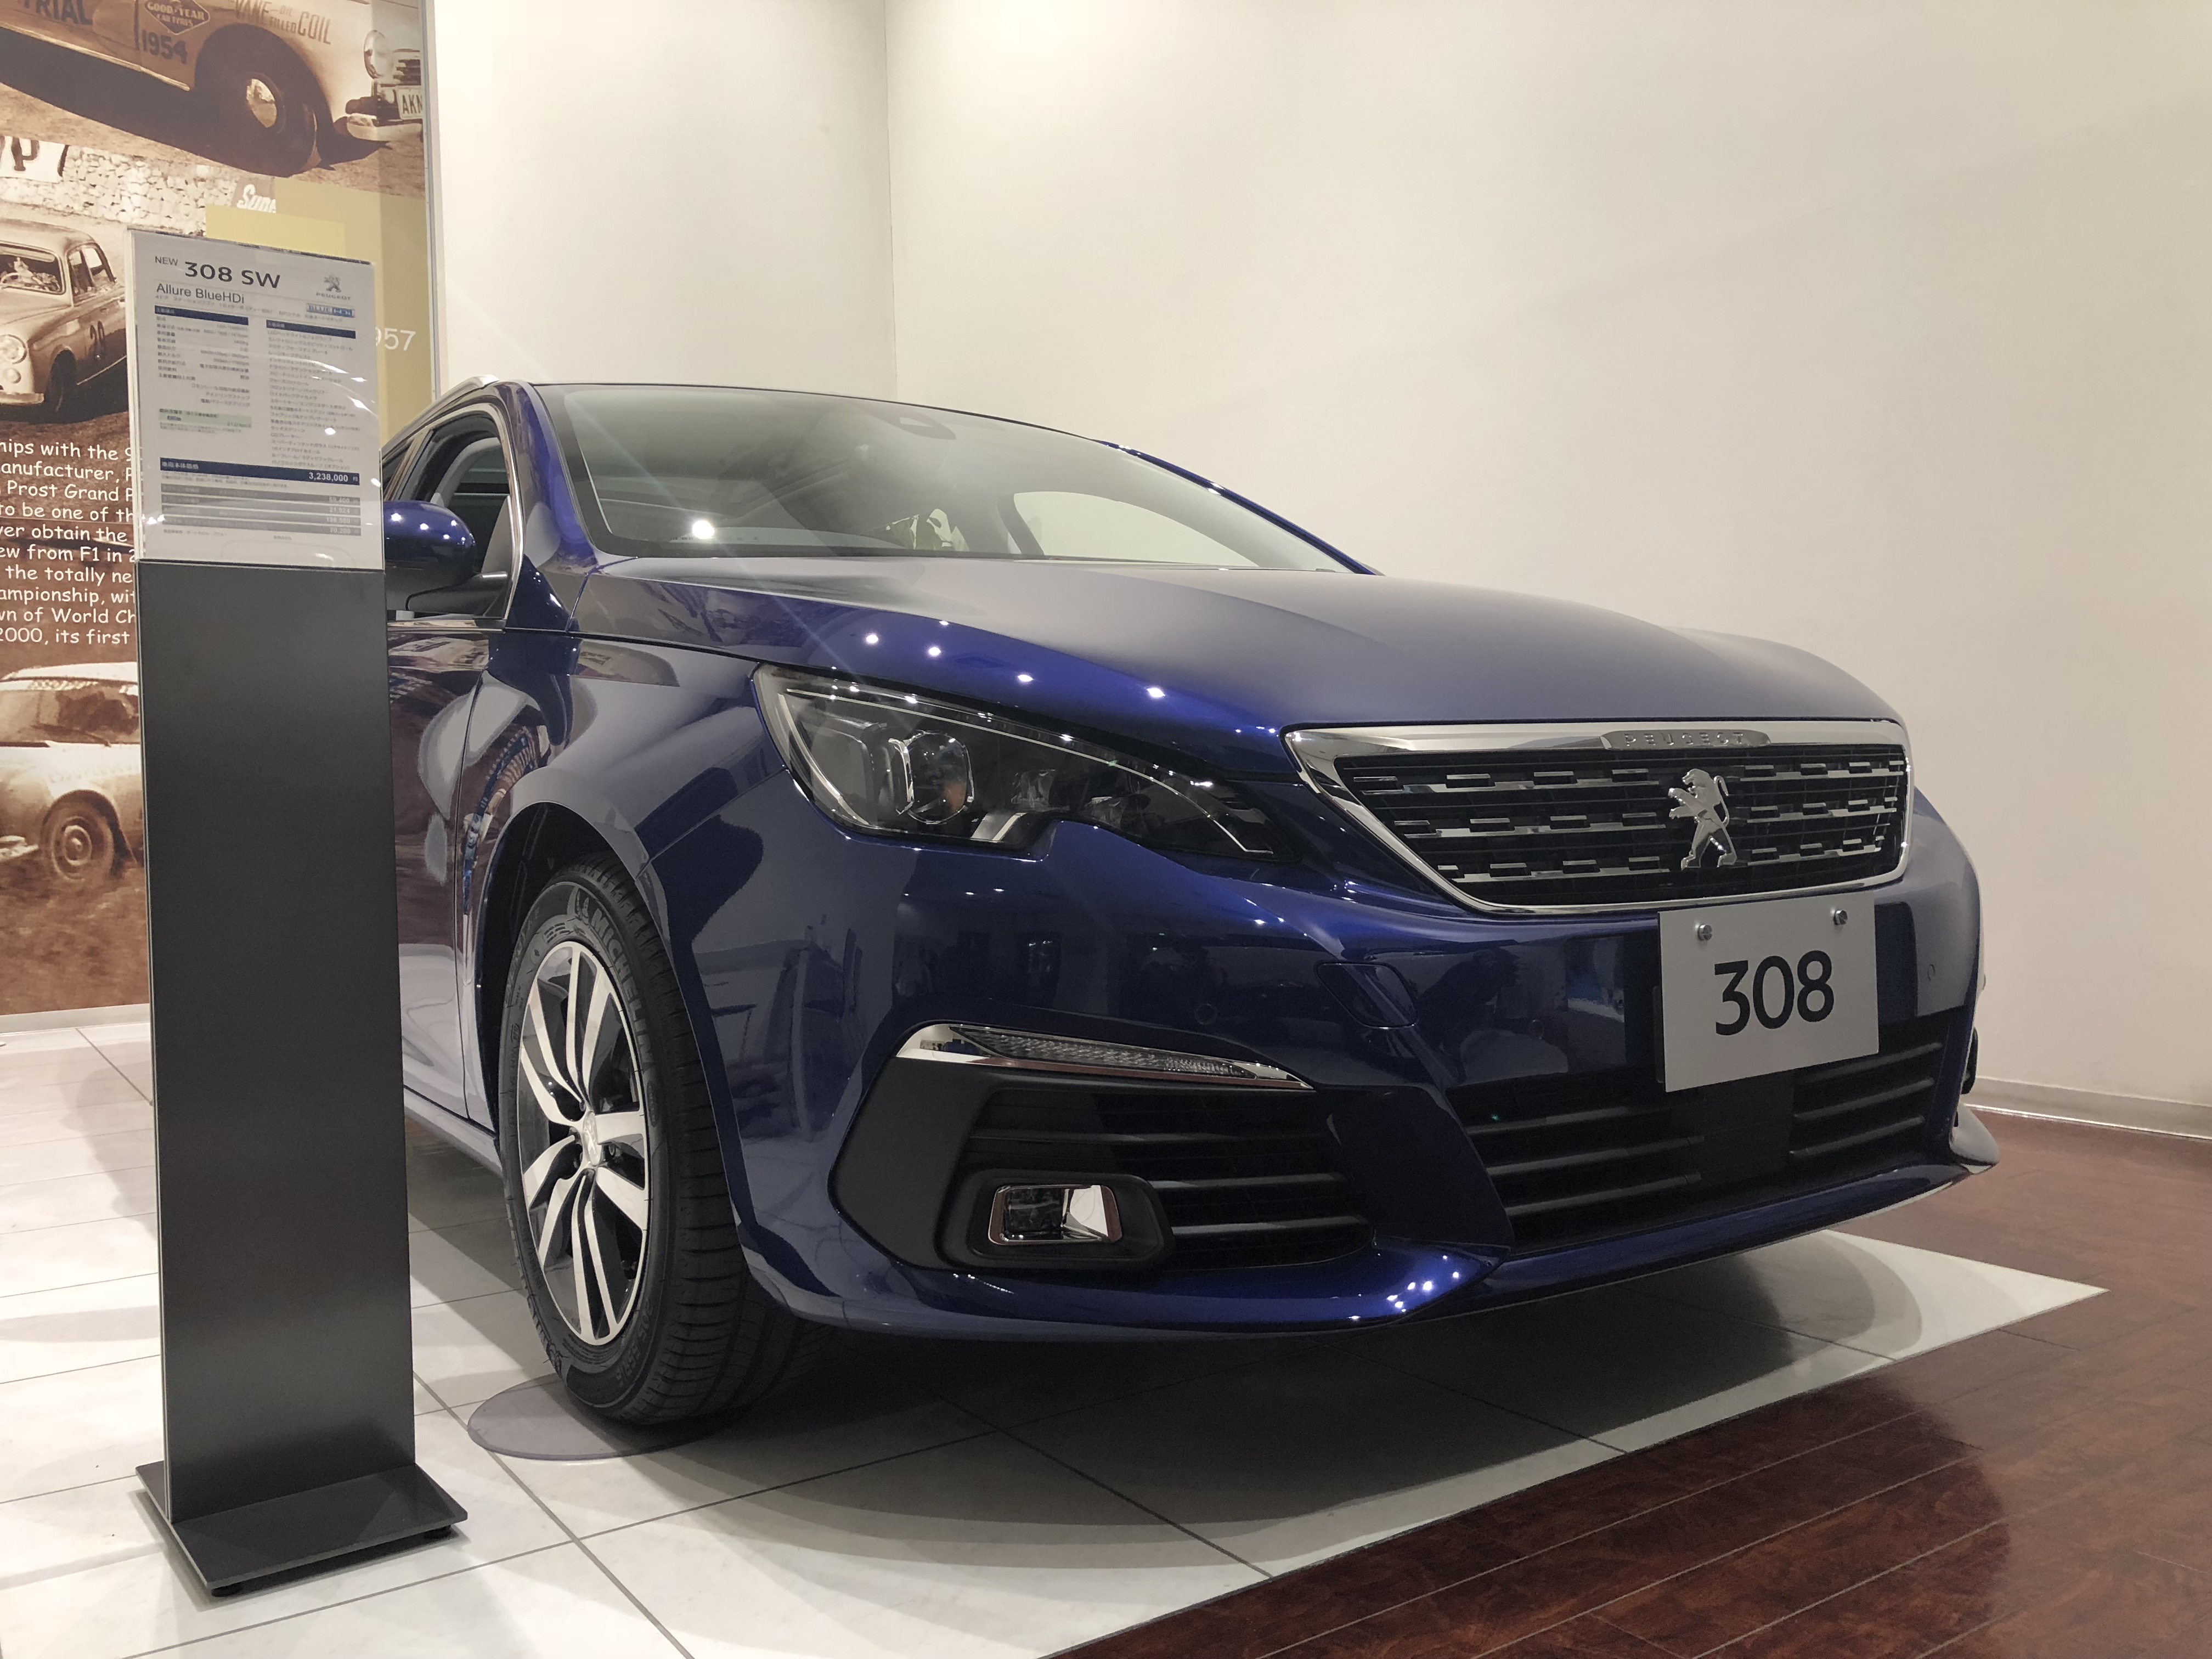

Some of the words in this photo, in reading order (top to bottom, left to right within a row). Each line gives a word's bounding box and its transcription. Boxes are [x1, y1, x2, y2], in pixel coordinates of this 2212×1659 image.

[297, 11, 331, 45] COIL
[142, 30, 188, 65] 1954
[155, 256, 178, 266] NEW
[185, 261, 233, 283] 308
[241, 269, 281, 289] SW
[156, 283, 191, 297] Allure
[195, 288, 245, 303] BlueHDi
[316, 292, 351, 301] PEUGEOT
[41, 442, 81, 458] with
[88, 444, 119, 460] the
[308, 472, 349, 482] 3,238,000
[7, 480, 58, 498] Prost
[65, 484, 119, 501] Grand
[22, 502, 45, 517] be
[52, 508, 83, 520] one
[90, 507, 109, 522] of
[31, 524, 90, 541] obtain
[96, 527, 127, 542] the
[27, 544, 73, 561] from
[80, 546, 99, 561] F1
[107, 548, 122, 562] in
[5, 564, 38, 580] the
[44, 567, 105, 586] totally
[112, 572, 133, 583] ne
[24, 607, 43, 623] of
[51, 608, 109, 623] World
[55, 629, 80, 644] its
[86, 629, 130, 645] first
[1624, 732, 1743, 747] PEUGEOT
[591, 908, 654, 1063] MICHELIN
[1714, 950, 1835, 1036] 308
